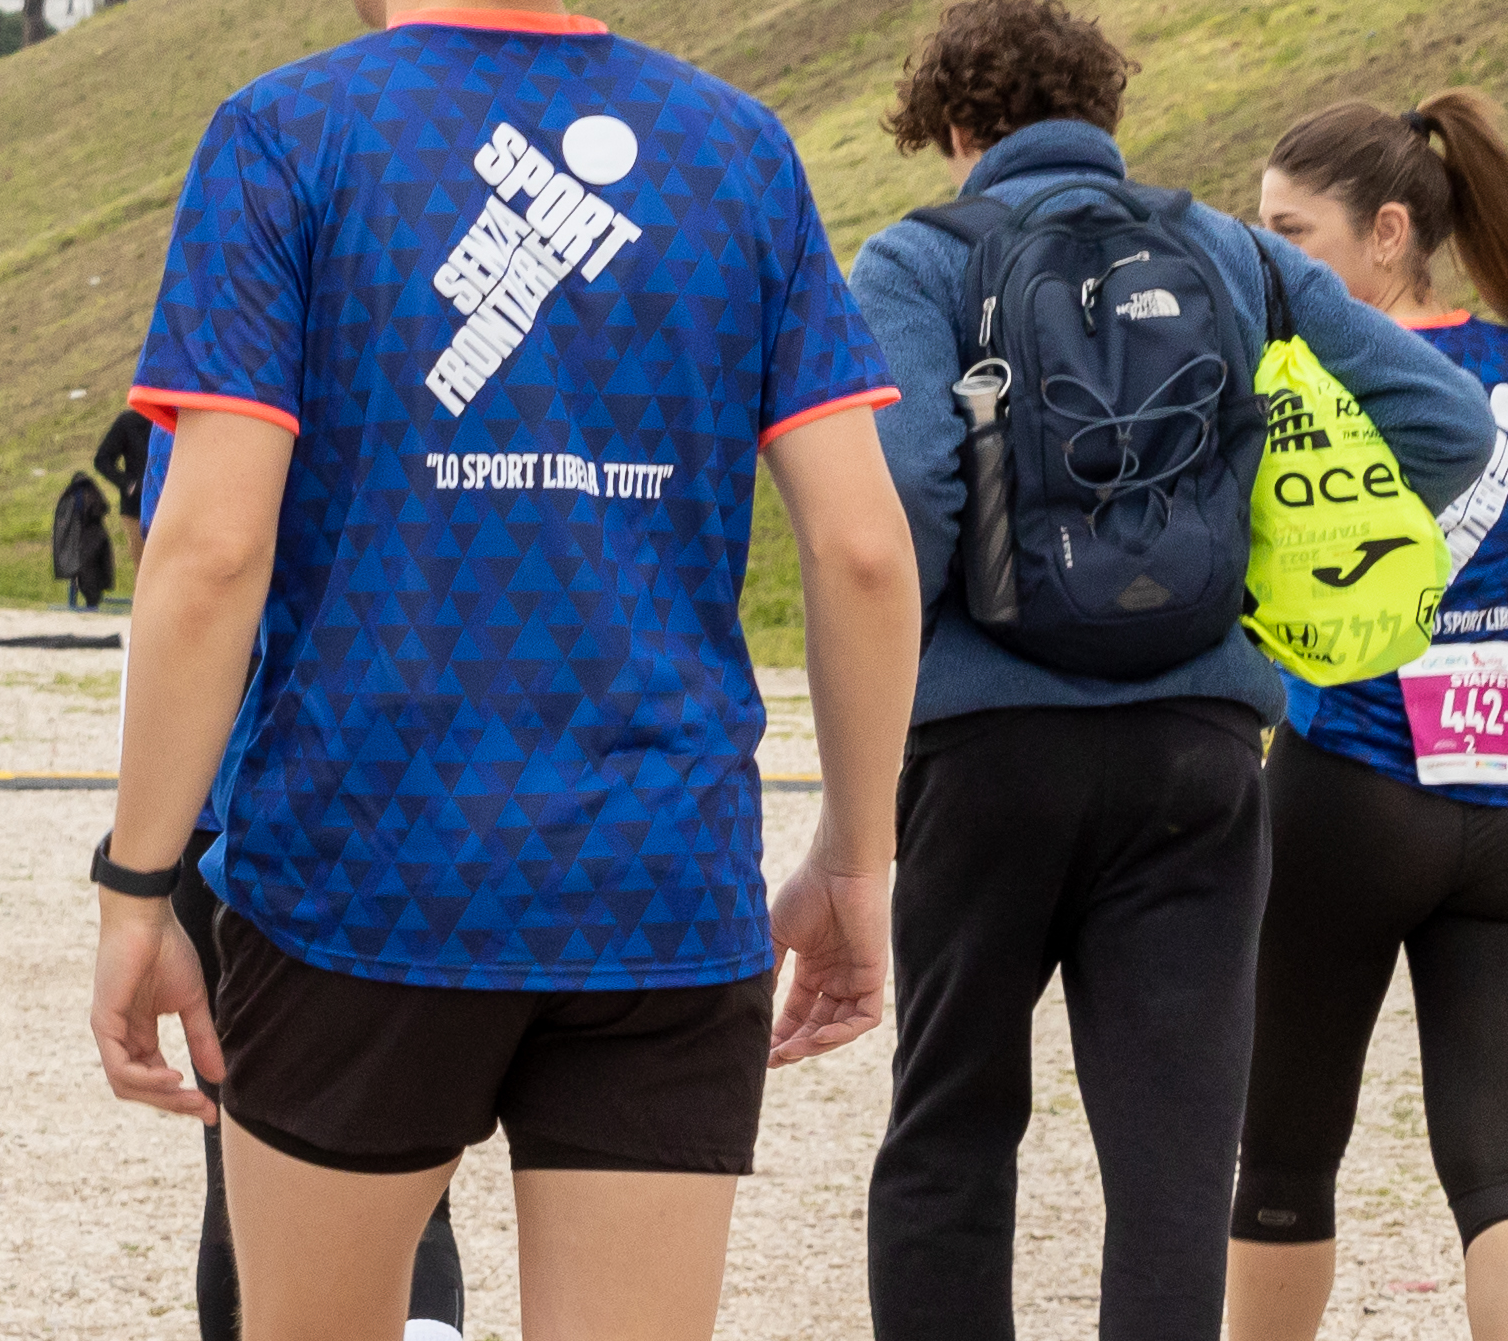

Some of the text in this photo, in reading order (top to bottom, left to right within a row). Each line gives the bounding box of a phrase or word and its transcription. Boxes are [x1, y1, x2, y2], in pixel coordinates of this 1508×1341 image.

[474, 122, 642, 283] SPORT
[433, 195, 535, 316] SENZA
[462, 452, 539, 489] SPORT
[1275, 463, 1412, 507] ace
[1443, 610, 1487, 635] SPORT
[1450, 672, 1508, 688] STAFFE
[1463, 734, 1476, 754] 2
